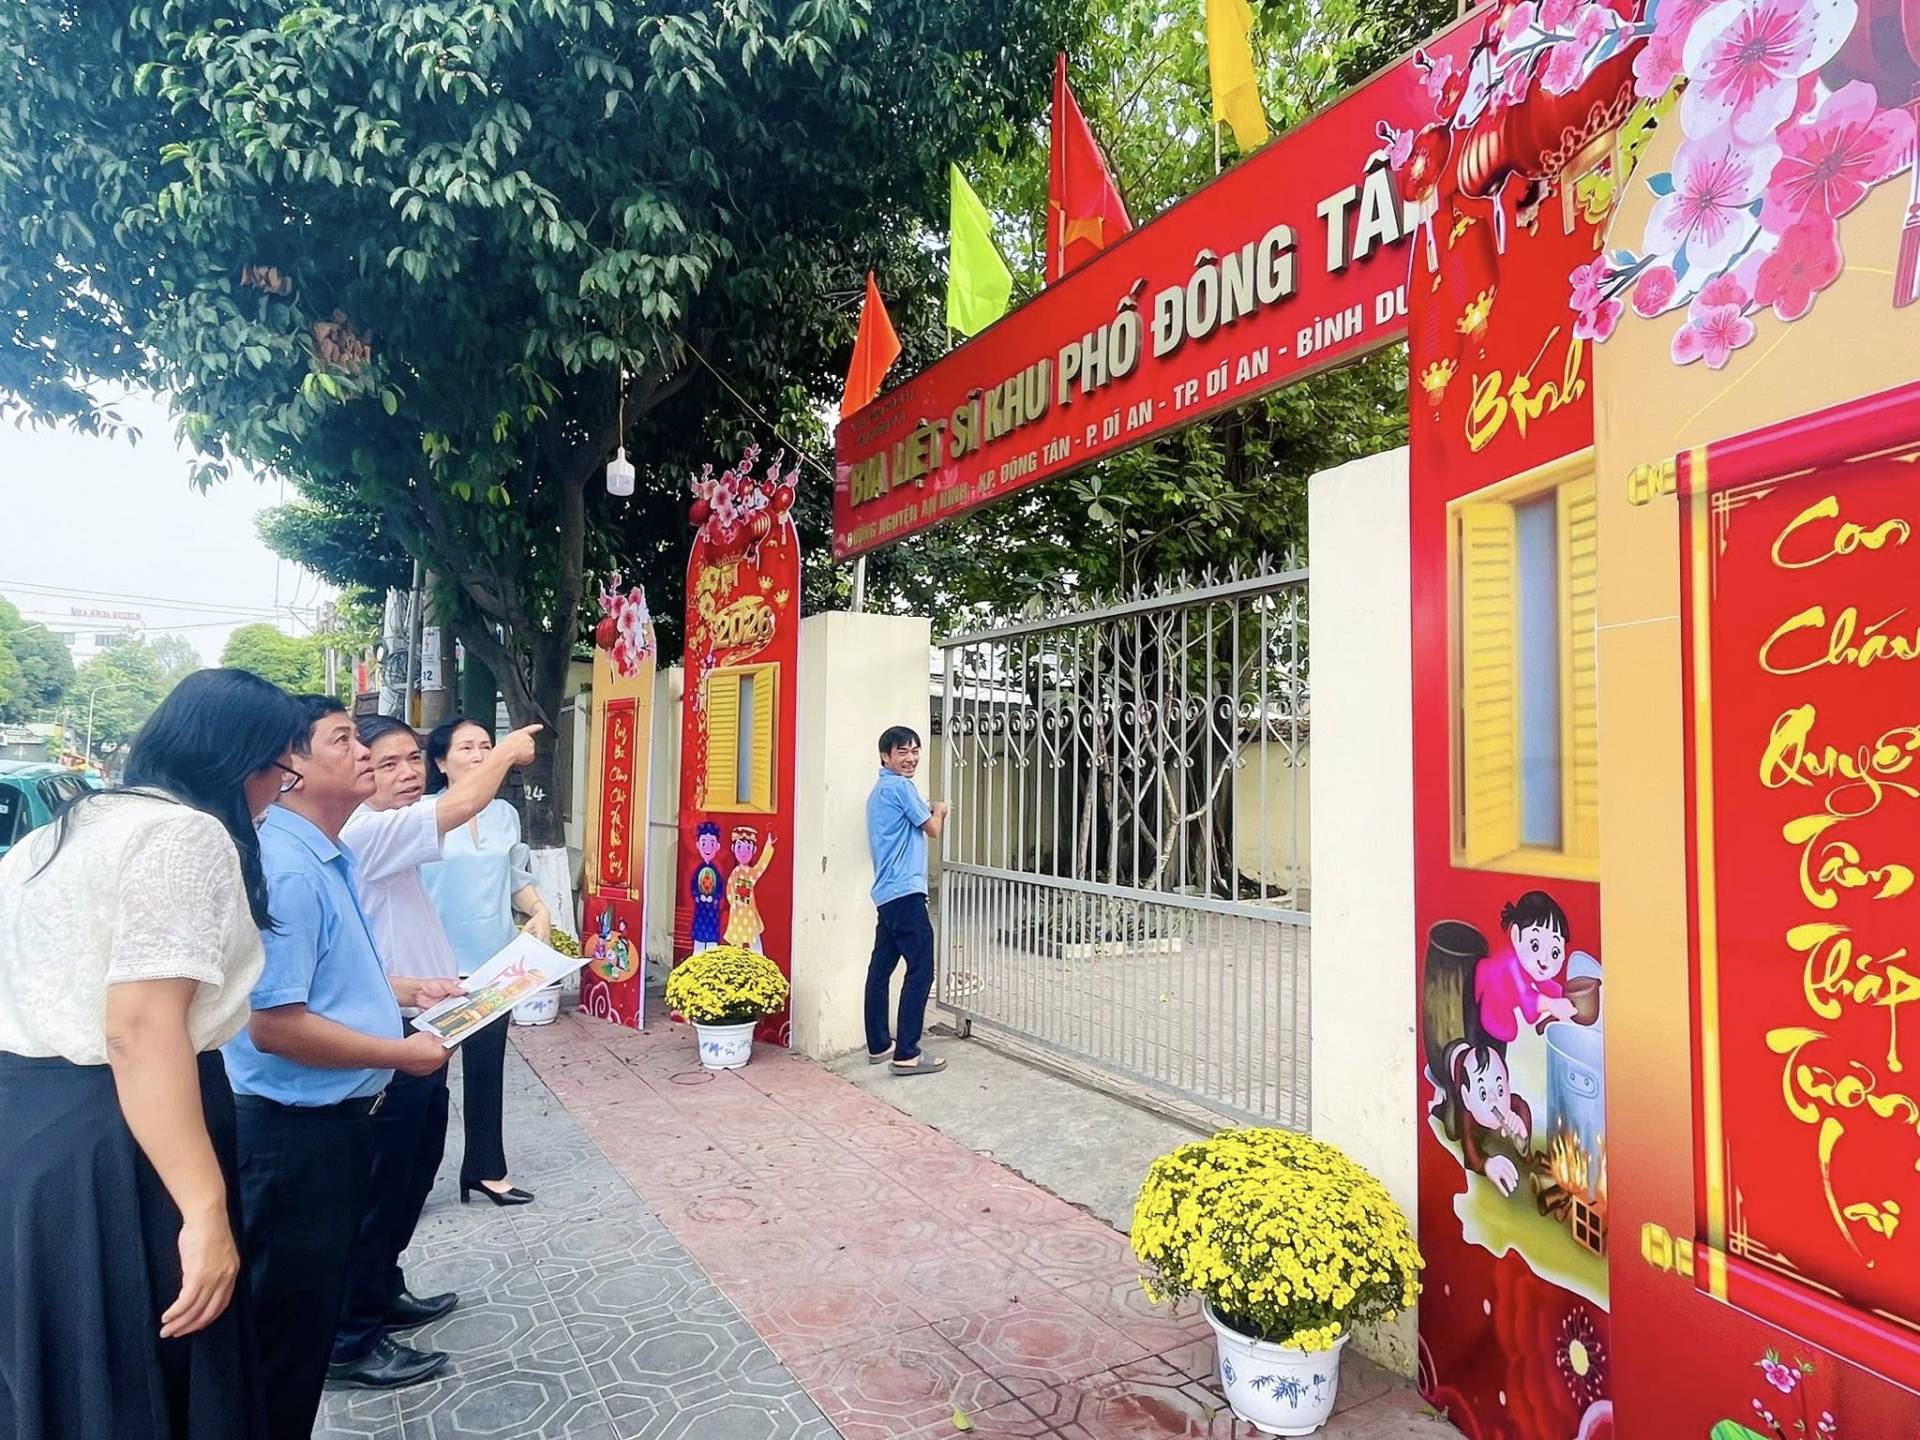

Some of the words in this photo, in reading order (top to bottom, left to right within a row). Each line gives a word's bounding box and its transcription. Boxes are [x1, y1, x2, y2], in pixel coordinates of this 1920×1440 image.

[851, 452, 888, 507] BIA
[892, 418, 948, 488] LIỆT
[985, 358, 1052, 442] KHU
[1058, 278, 1147, 406] PHỐ
[1151, 224, 1298, 358] ĐÔNG
[1001, 451, 1037, 484] ĐÔNG
[1042, 436, 1070, 465] TÂN
[1087, 424, 1097, 448] P.
[1127, 399, 1152, 431] AN
[1173, 379, 1199, 410] TP.
[1207, 360, 1228, 398] DĨ
[1236, 346, 1269, 385] AN
[1297, 304, 1362, 358] BÌNH
[1465, 326, 1586, 452] Bính
[1771, 495, 1911, 569] Con
[423, 670, 433, 681] 12
[713, 605, 773, 649] 2026
[1759, 605, 1920, 675] Cháu
[1759, 704, 1920, 817] Quyế
[1782, 814, 1915, 909] Tâm
[1786, 922, 1920, 1073] Thắp
[1766, 1027, 1920, 1171] Tươn
[1818, 1117, 1900, 1268] Lai
